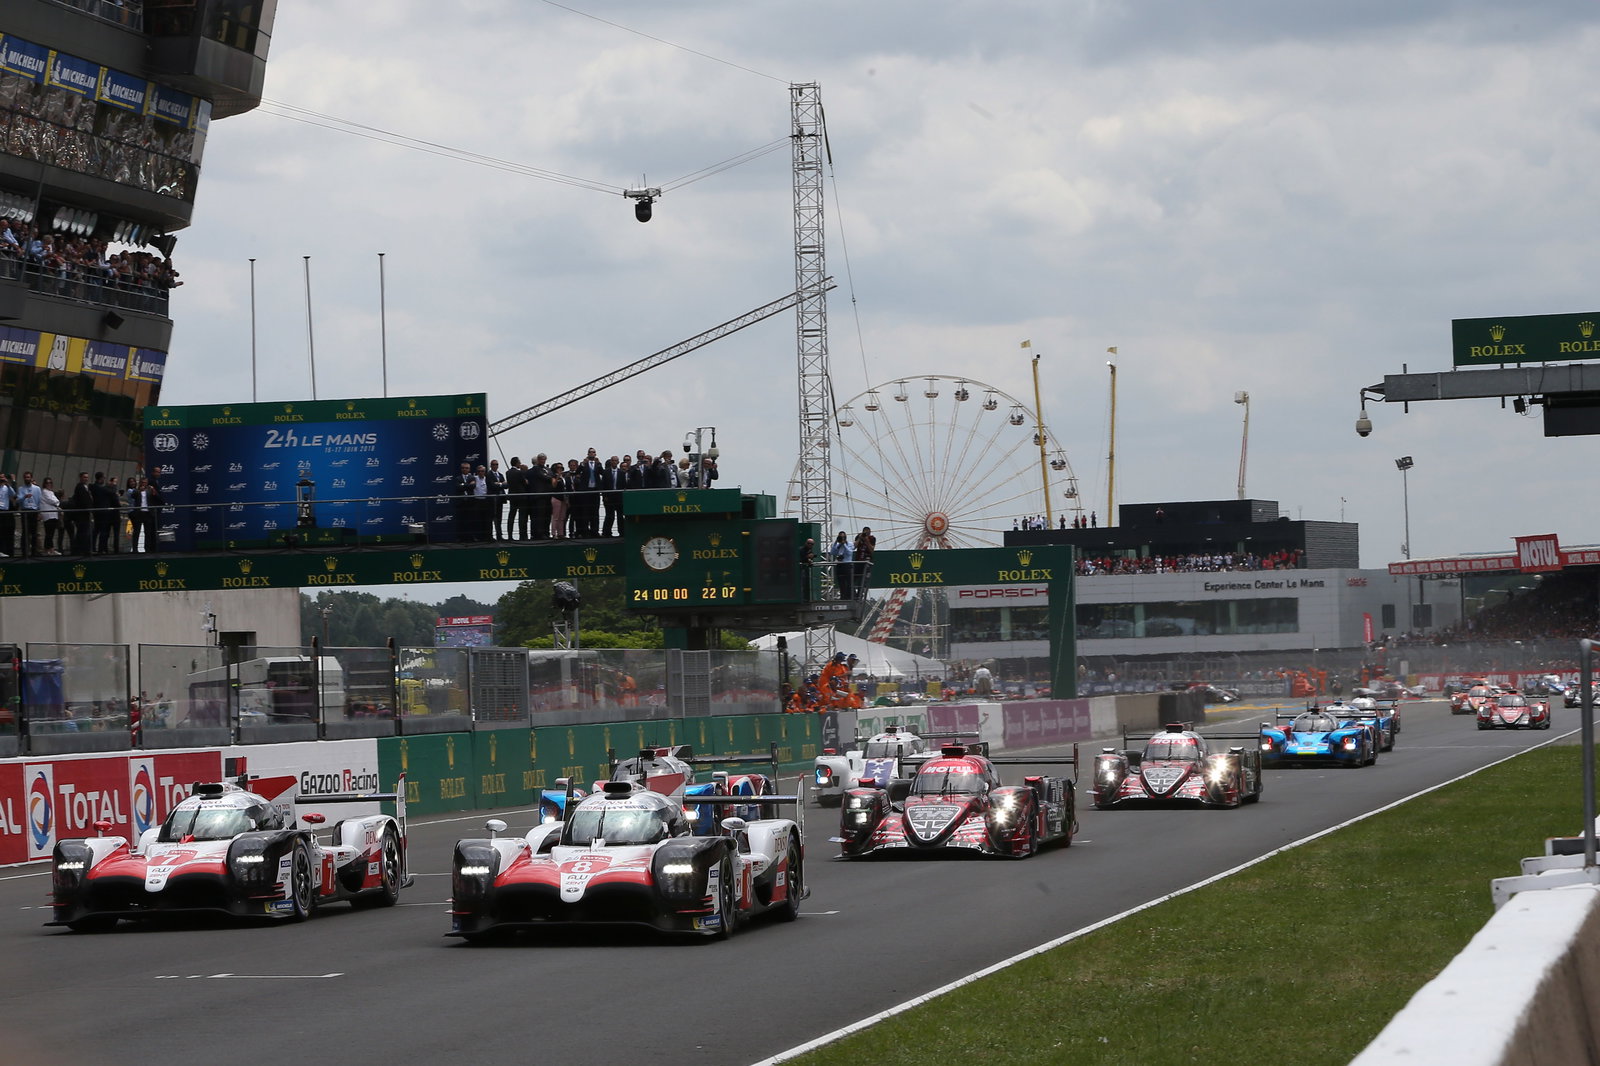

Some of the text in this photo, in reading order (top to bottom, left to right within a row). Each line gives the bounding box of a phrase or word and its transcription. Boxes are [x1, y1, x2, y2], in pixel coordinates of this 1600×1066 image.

[7, 50, 45, 73] MICHELIN
[61, 67, 96, 89] MICHELIN
[111, 83, 145, 104] MICHELIN
[158, 98, 190, 118] MICHELIN
[0, 339, 36, 356] MICHELIN
[1470, 343, 1527, 357] ROLEX
[1559, 340, 1600, 353] ROLE
[92, 353, 127, 370] MICHELIN
[335, 411, 365, 420] ROLEX
[397, 408, 428, 417] ROLEX
[457, 406, 481, 415] ROLEX
[212, 416, 242, 425] ROLEX
[274, 414, 304, 422] ROLEX
[301, 435, 324, 447] LE
[326, 432, 377, 446] MANS
[663, 504, 701, 513] ROLEX
[692, 548, 739, 560] ROLEX
[1519, 538, 1559, 568] MOTUL
[393, 570, 442, 582] ROLEX
[479, 567, 529, 579] ROLEX
[566, 564, 616, 577] ROLEX
[998, 568, 1053, 581] ROLEX
[139, 578, 187, 590] ROLEX
[222, 576, 271, 588] ROLEX
[307, 573, 356, 585] ROLEX
[890, 572, 944, 584] ROLEX
[57, 581, 103, 593] ROLEX
[1204, 578, 1325, 593] Experience Center Le Mans
[634, 588, 688, 601] 24 00 00
[702, 586, 736, 599] 22 07
[959, 587, 1048, 599] PORSCH
[342, 767, 378, 794] Racing
[482, 773, 506, 794] ROLEX
[523, 770, 546, 790] ROLEX
[440, 777, 465, 800] ROLEX
[59, 783, 127, 831] TOTAL
[162, 854, 181, 864] 7
[571, 861, 593, 872] 8
